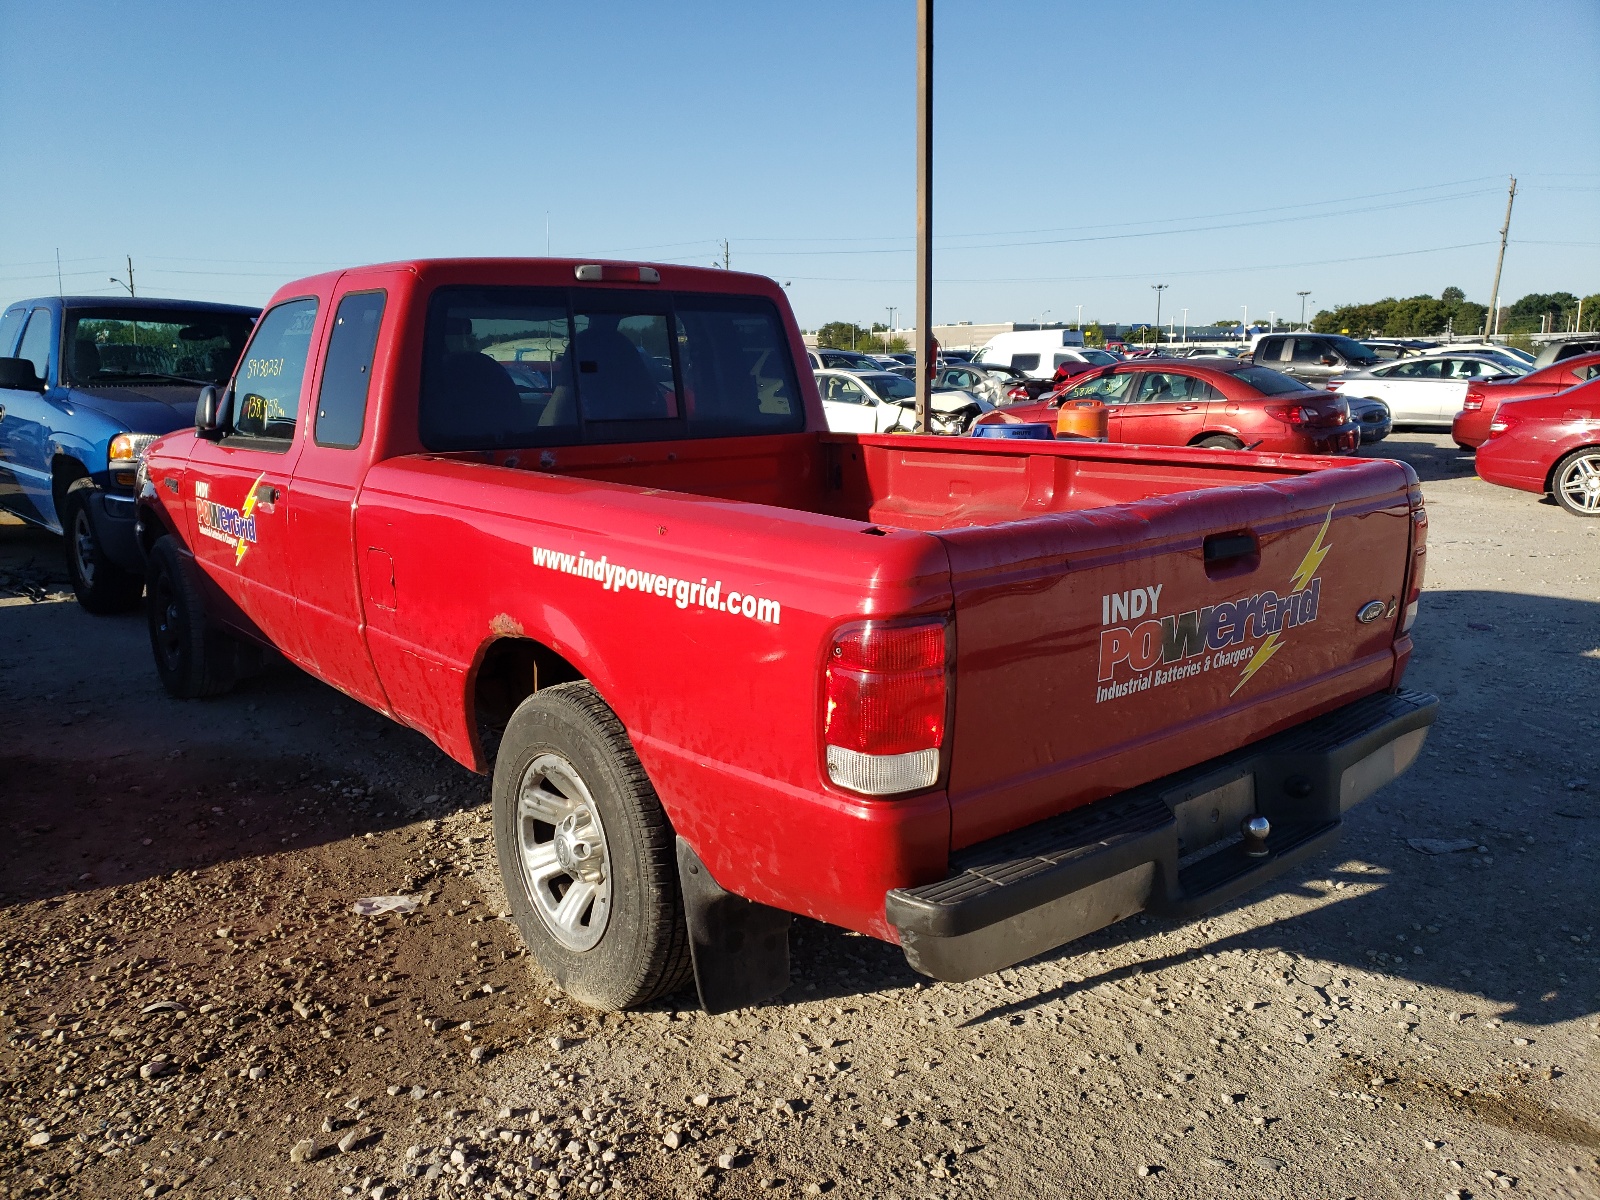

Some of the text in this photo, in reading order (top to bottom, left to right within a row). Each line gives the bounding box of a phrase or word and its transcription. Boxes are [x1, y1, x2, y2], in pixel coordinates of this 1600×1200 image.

[195, 480, 209, 498] INDY
[532, 546, 781, 625] www.indypowergrid.com
[1102, 583, 1163, 626] INDY
[1096, 645, 1254, 704] Industrial Batteries & Chargers
